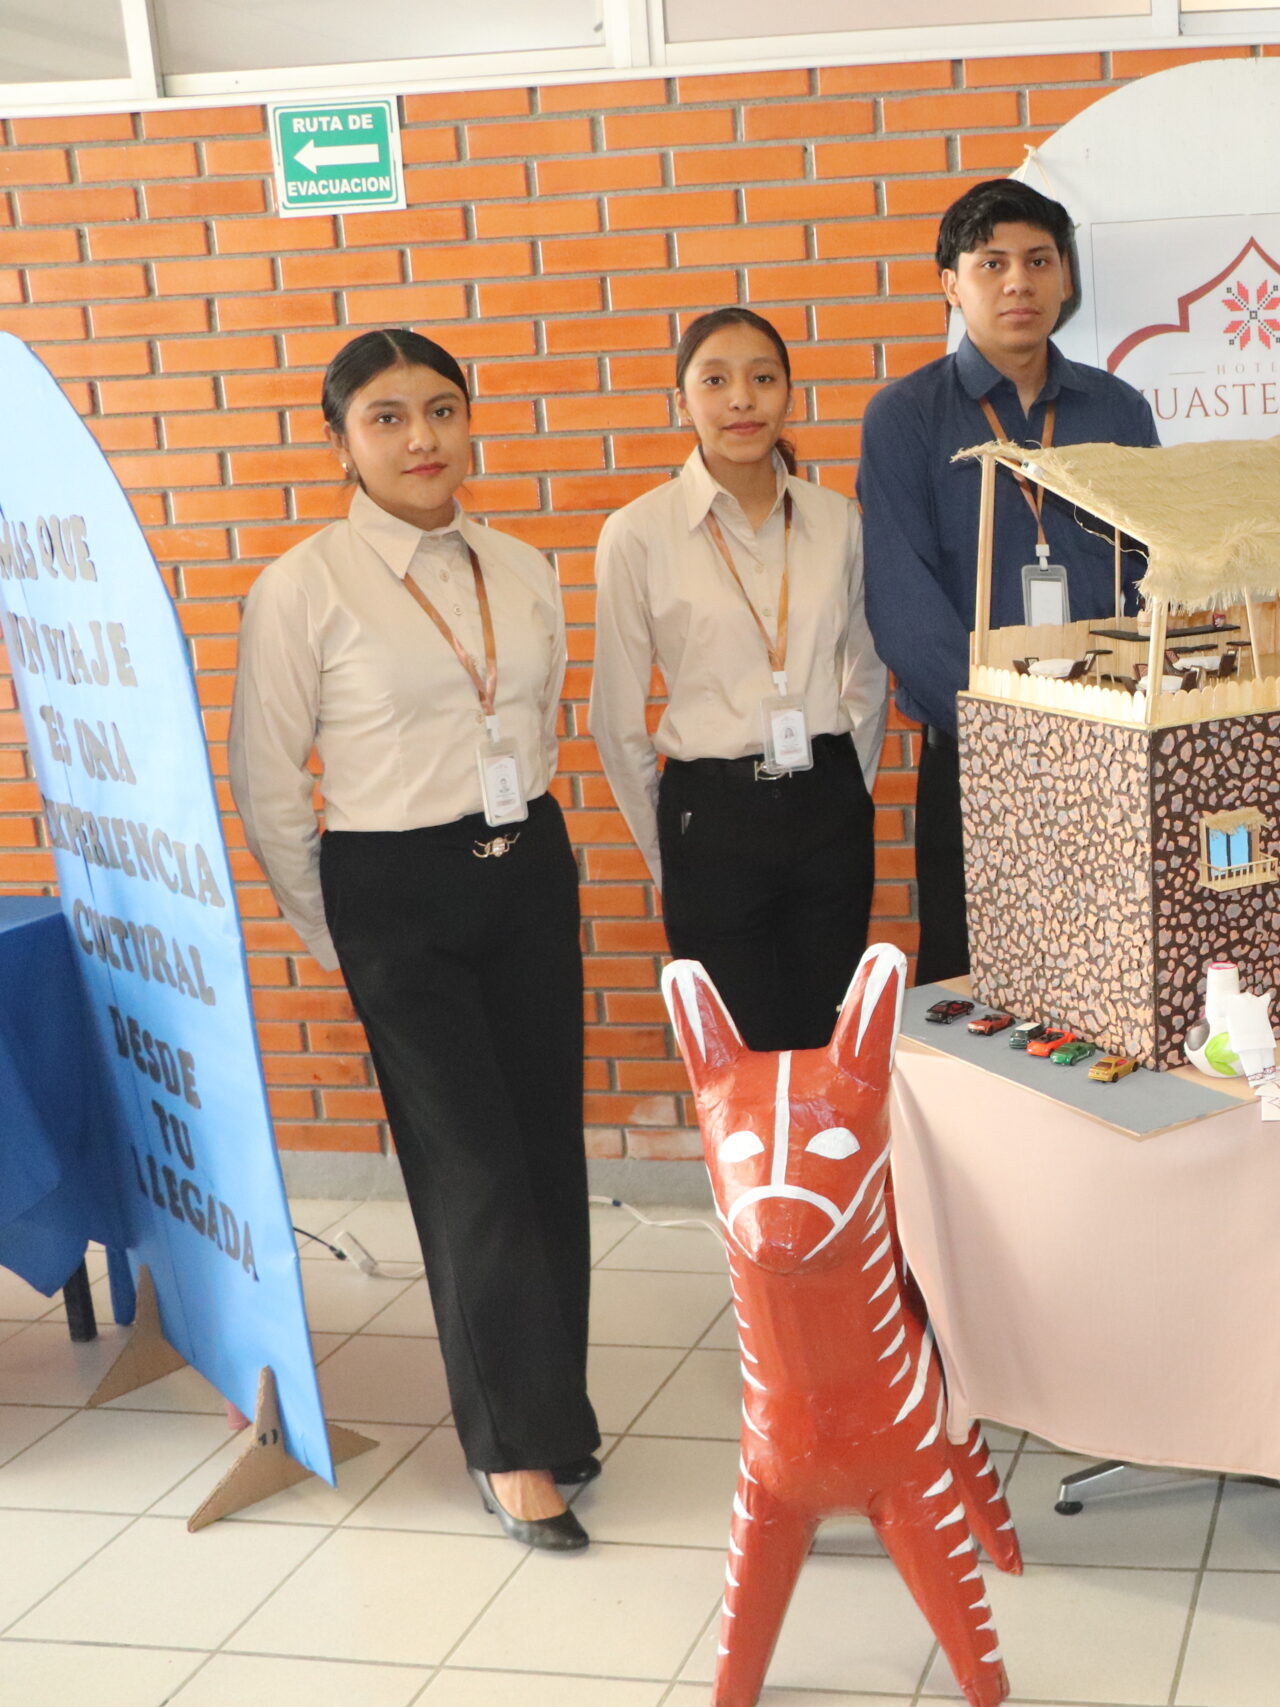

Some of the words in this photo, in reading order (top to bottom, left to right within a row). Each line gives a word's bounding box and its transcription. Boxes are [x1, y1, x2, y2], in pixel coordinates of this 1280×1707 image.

[292, 116, 344, 134] RUTA
[348, 113, 374, 130] DE
[287, 176, 391, 197] EVACUACION
[36, 513, 98, 583] QUE
[7, 610, 46, 675] UN
[40, 620, 139, 688] VIAJE
[39, 704, 73, 767] ES
[73, 717, 137, 786] UNA
[72, 897, 217, 1007] CULTURAL
[108, 1004, 202, 1110] DESDE
[151, 1098, 196, 1171] TU
[130, 1142, 260, 1282] LLEGADA
